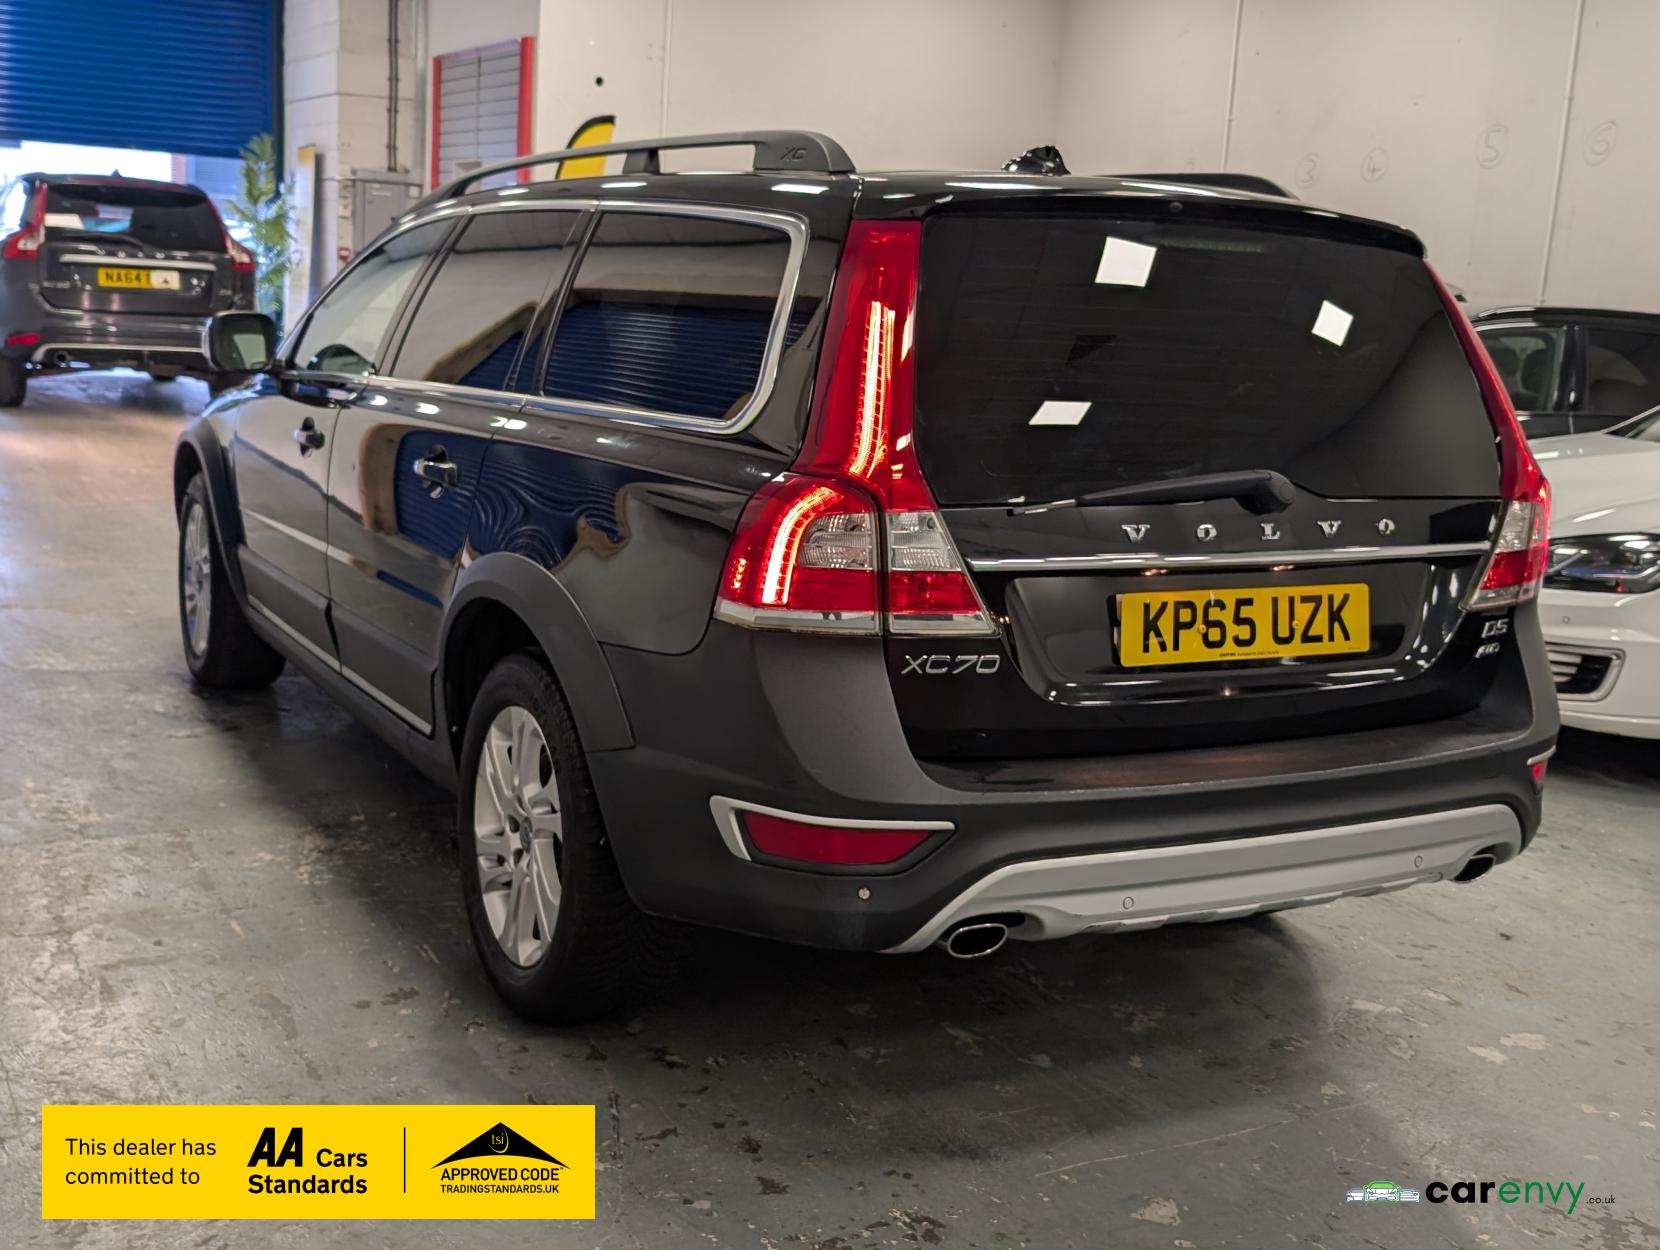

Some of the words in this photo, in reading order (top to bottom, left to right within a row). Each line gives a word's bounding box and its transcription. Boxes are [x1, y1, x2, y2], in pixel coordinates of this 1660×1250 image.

[1480, 126, 1509, 165] 5
[1300, 157, 1318, 185] 3
[1365, 152, 1385, 179] 4
[1121, 518, 1396, 544] VOLVO
[1142, 597, 1257, 654] KP65
[1271, 592, 1351, 646] UZK
[1481, 618, 1508, 638] D5
[901, 654, 1001, 675] XC70
